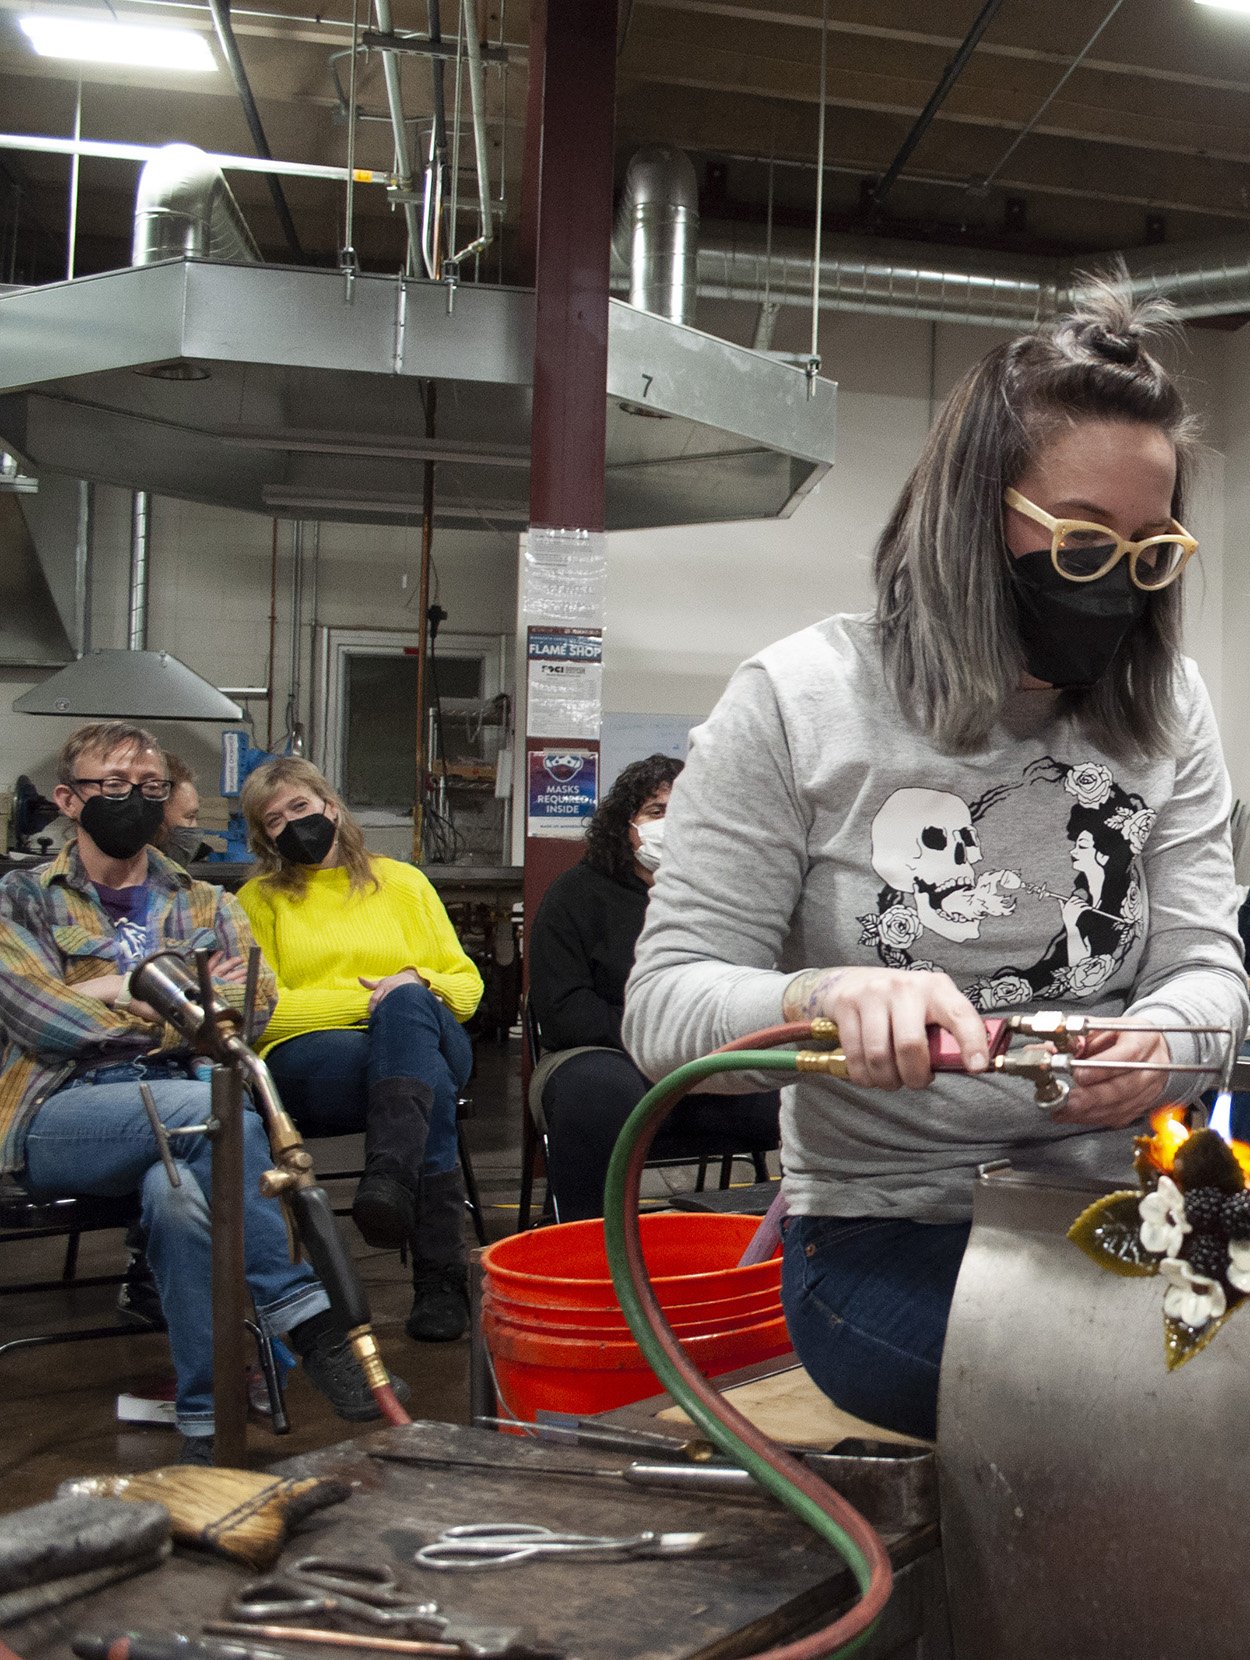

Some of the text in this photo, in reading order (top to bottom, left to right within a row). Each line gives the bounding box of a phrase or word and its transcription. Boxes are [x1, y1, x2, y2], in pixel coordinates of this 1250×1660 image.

[642, 373, 653, 398] 7
[529, 643, 601, 657] FLAME SHOP
[546, 785, 580, 793] MASKS
[537, 795, 589, 804] REQUIRED
[546, 805, 580, 813] INSIDE
